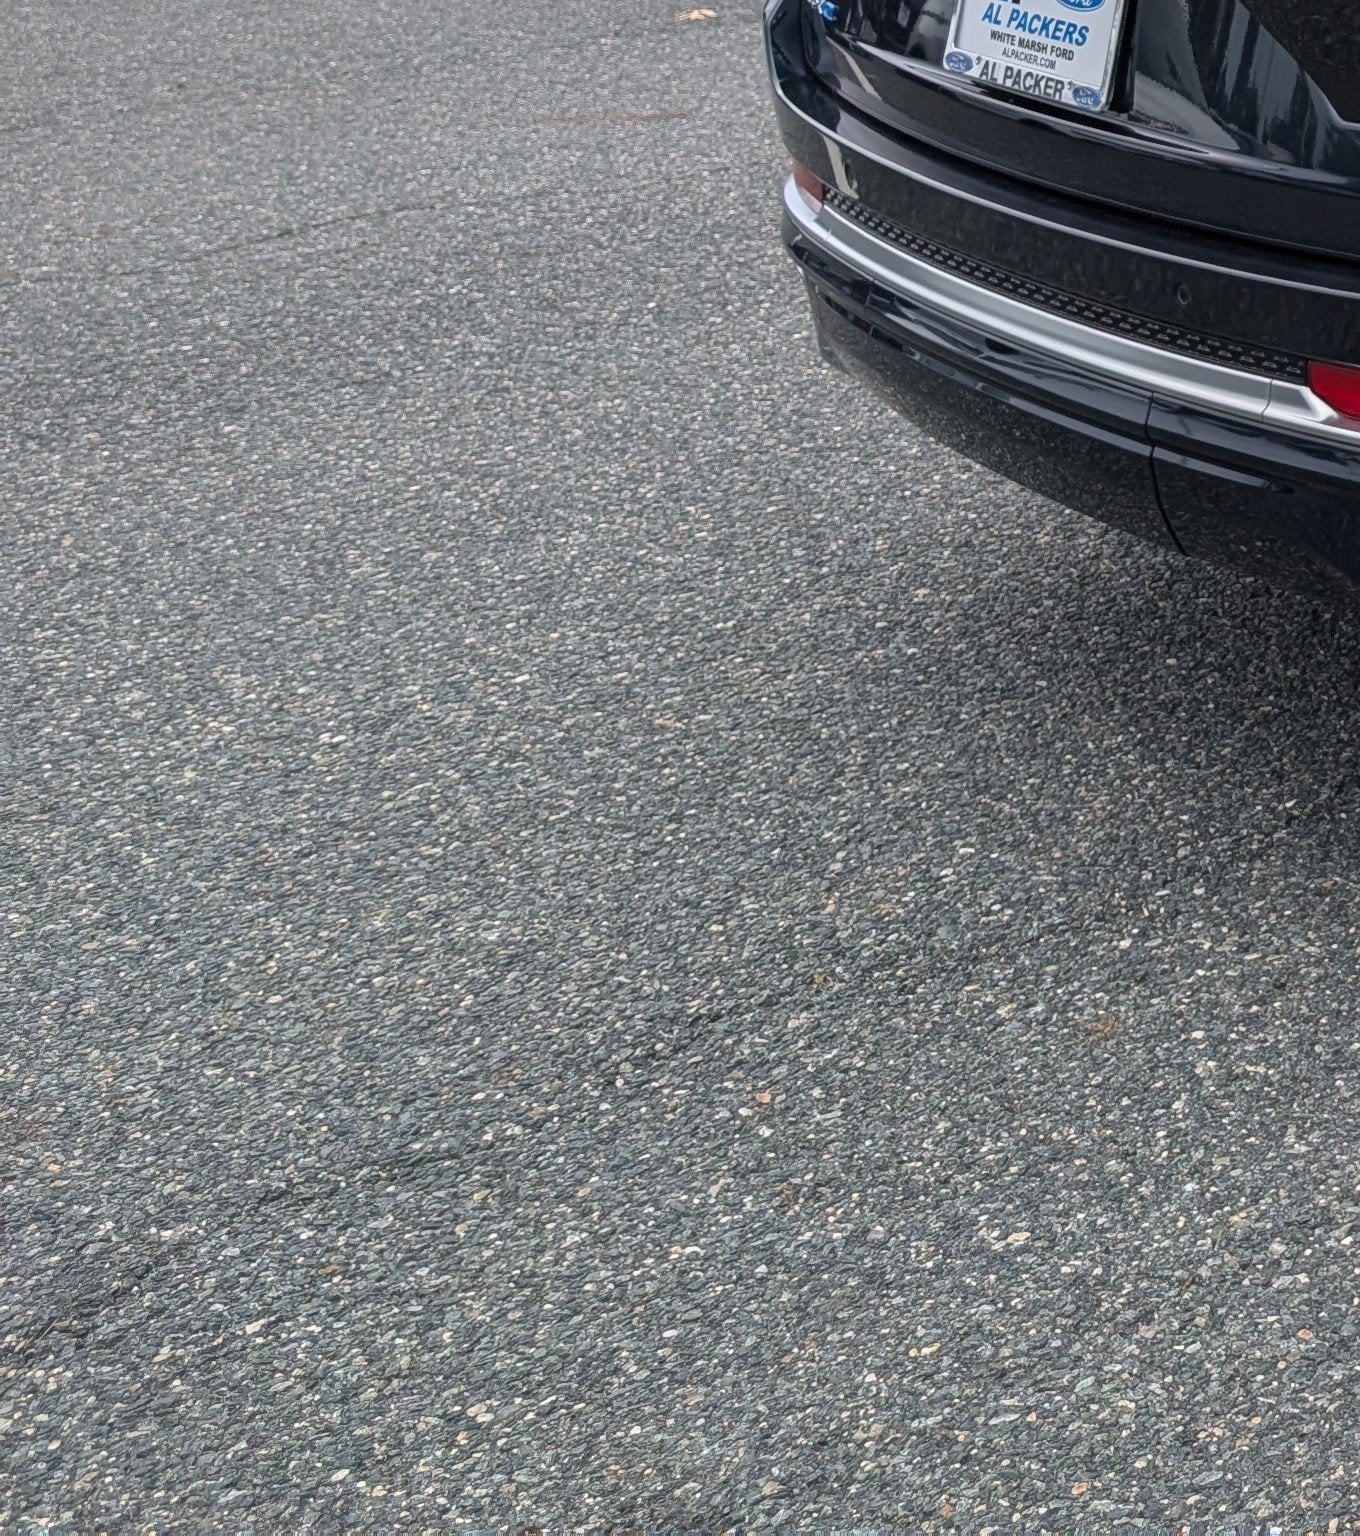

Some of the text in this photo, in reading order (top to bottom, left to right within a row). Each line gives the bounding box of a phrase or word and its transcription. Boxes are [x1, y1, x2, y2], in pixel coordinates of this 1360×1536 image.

[981, 2, 1090, 47] AL PACKERS
[990, 29, 1074, 62] WHITE MARSH FORD
[1001, 47, 1057, 71] ALPACKER.COM
